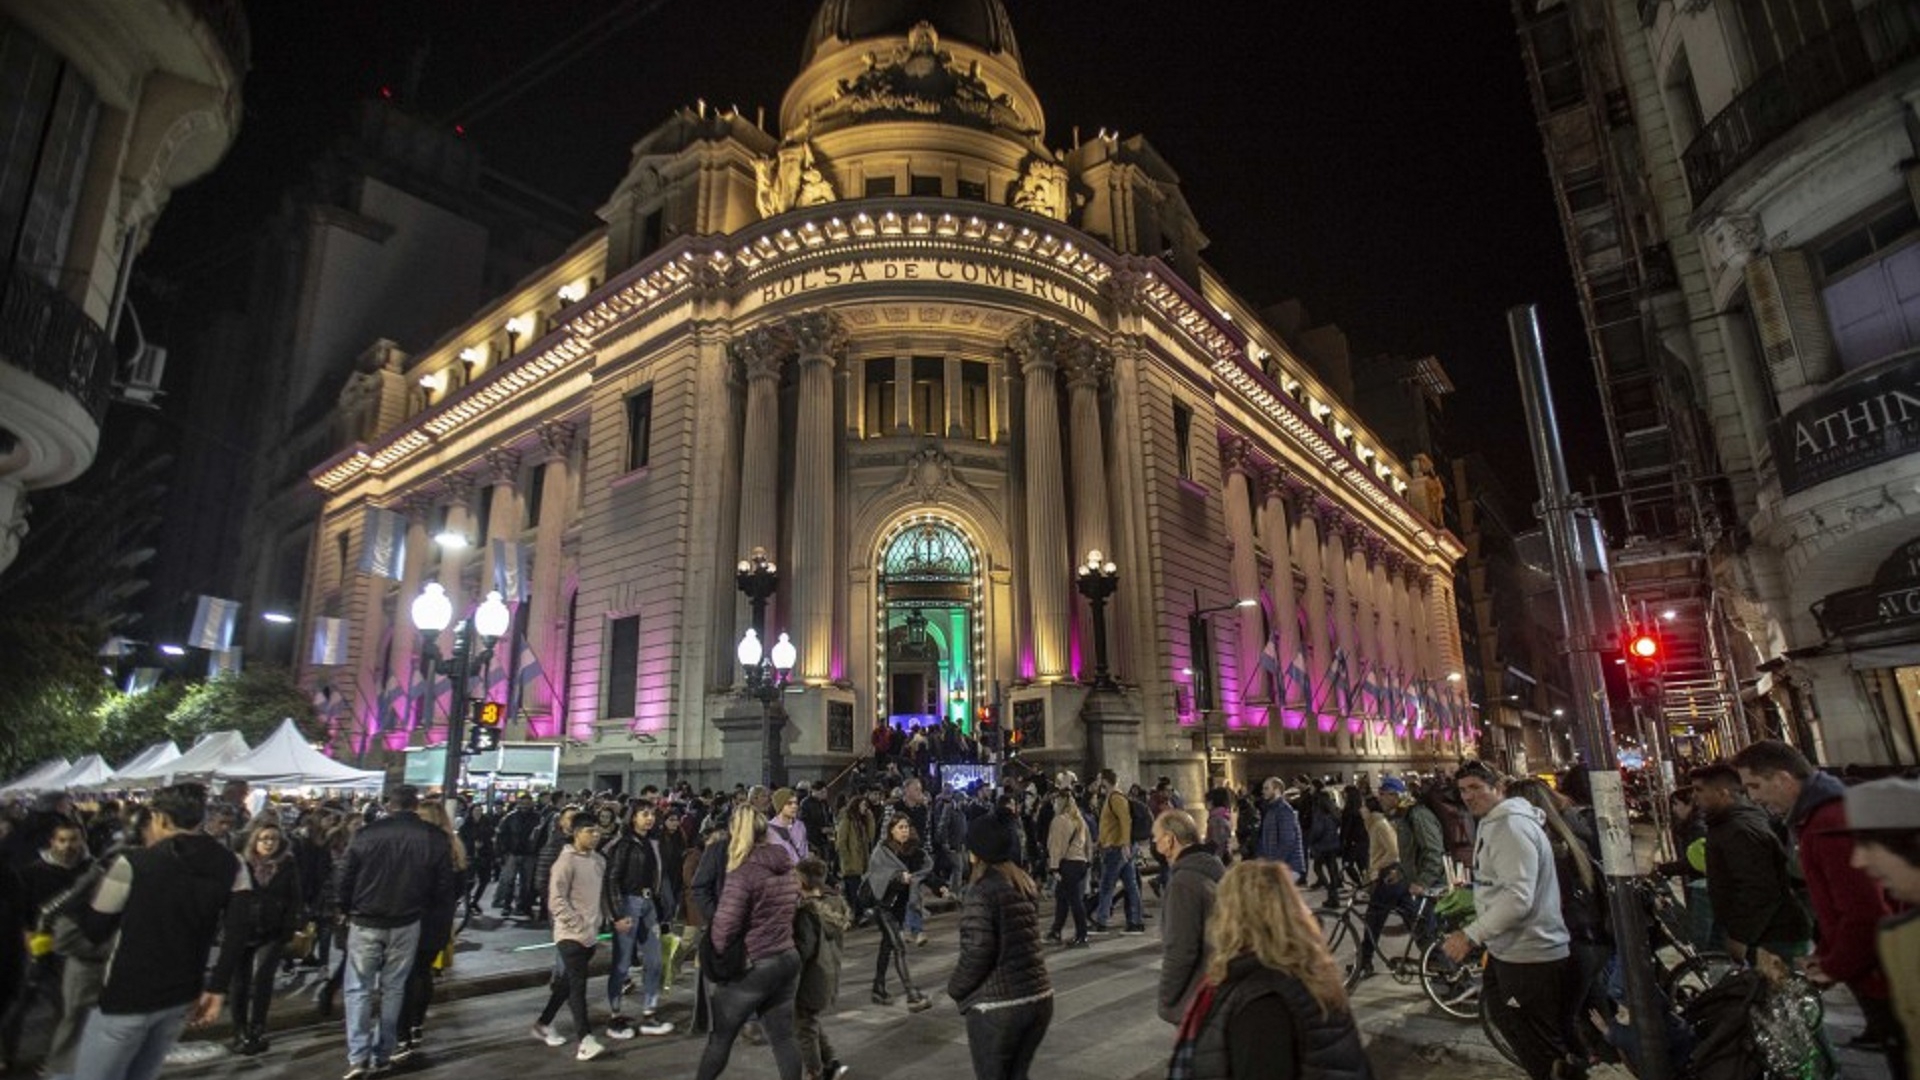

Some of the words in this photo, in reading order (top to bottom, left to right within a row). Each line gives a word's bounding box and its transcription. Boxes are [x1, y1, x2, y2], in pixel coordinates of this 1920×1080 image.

[763, 262, 869, 303] BOLSA
[884, 262, 920, 280] DE
[936, 259, 1089, 315] COMERCIO
